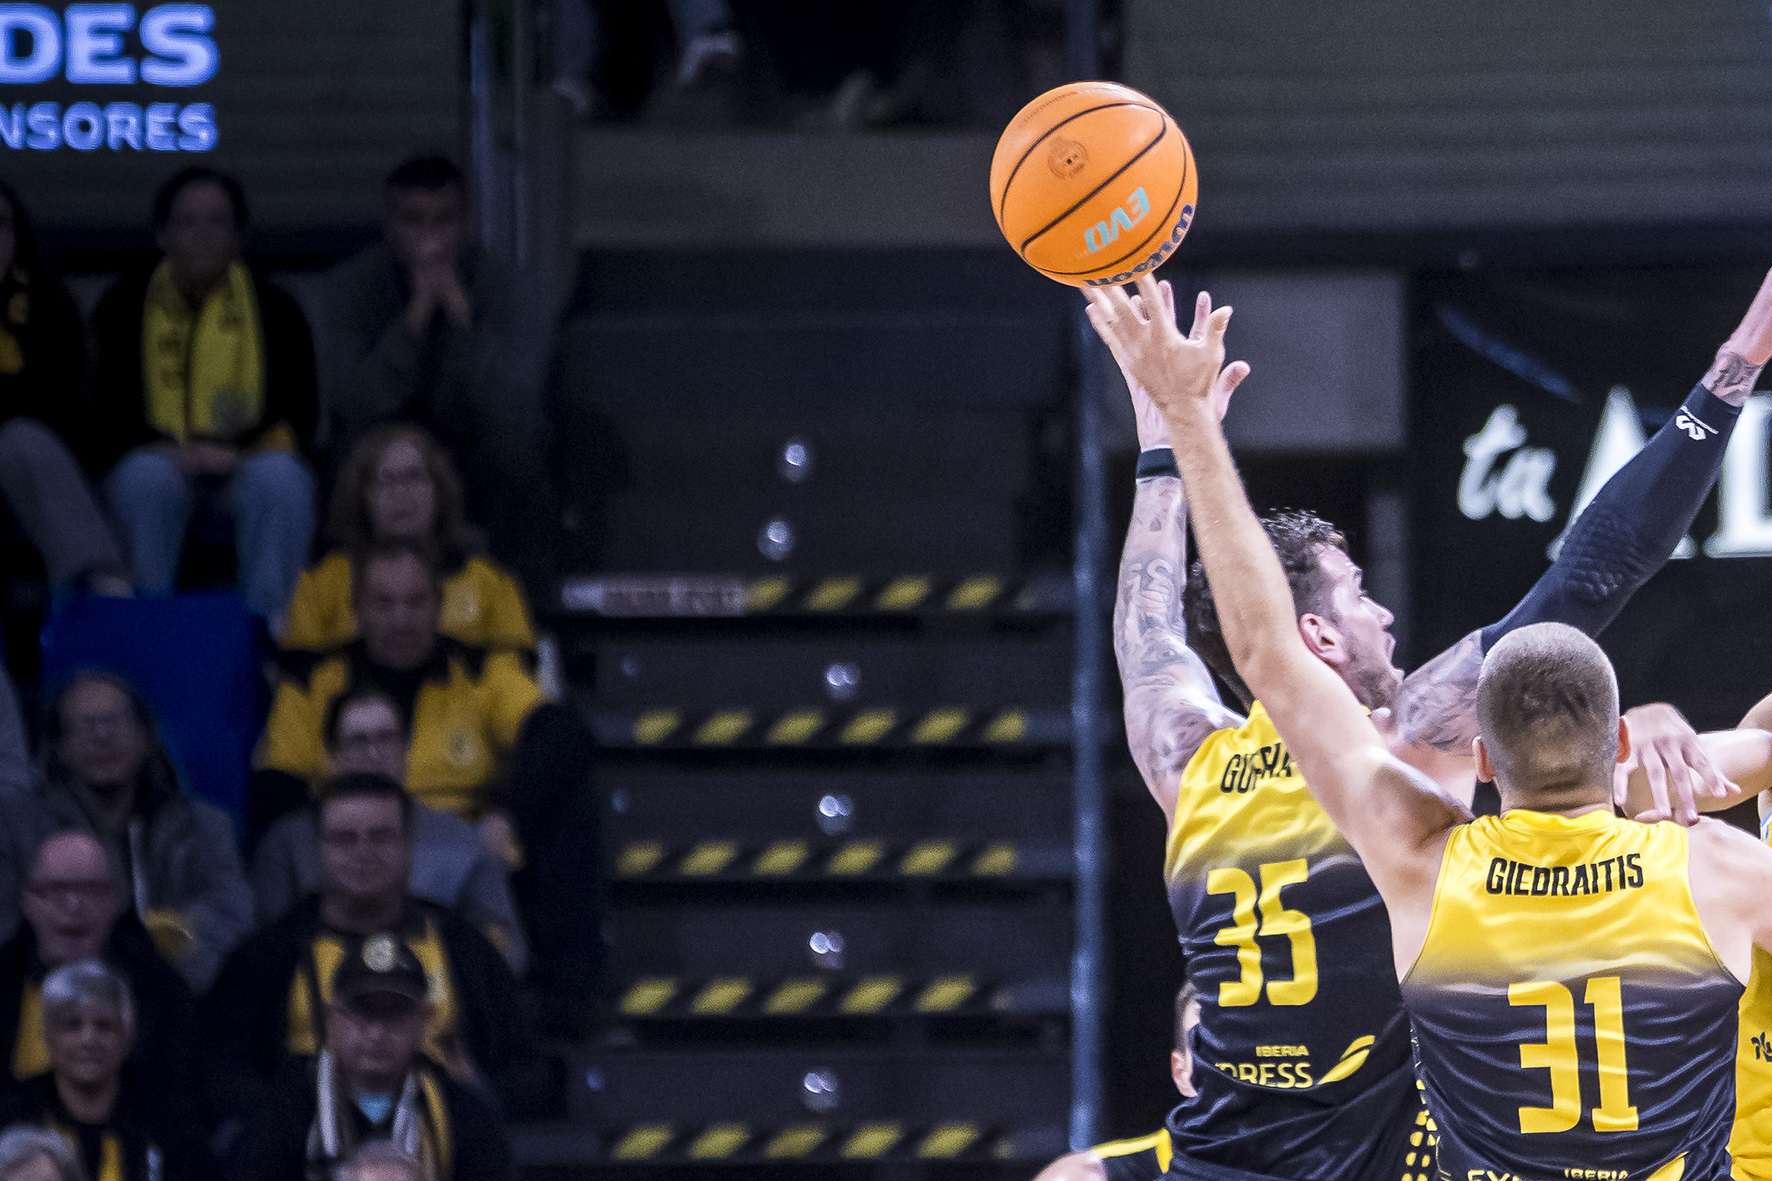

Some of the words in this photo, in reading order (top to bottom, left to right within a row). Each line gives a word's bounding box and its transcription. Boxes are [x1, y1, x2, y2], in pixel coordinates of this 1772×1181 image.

[1485, 852, 1645, 897] GIEDRAITIS
[1206, 858, 1319, 1008] 35
[1256, 1045, 1310, 1058] IBERIA
[1507, 976, 1640, 1134] 31
